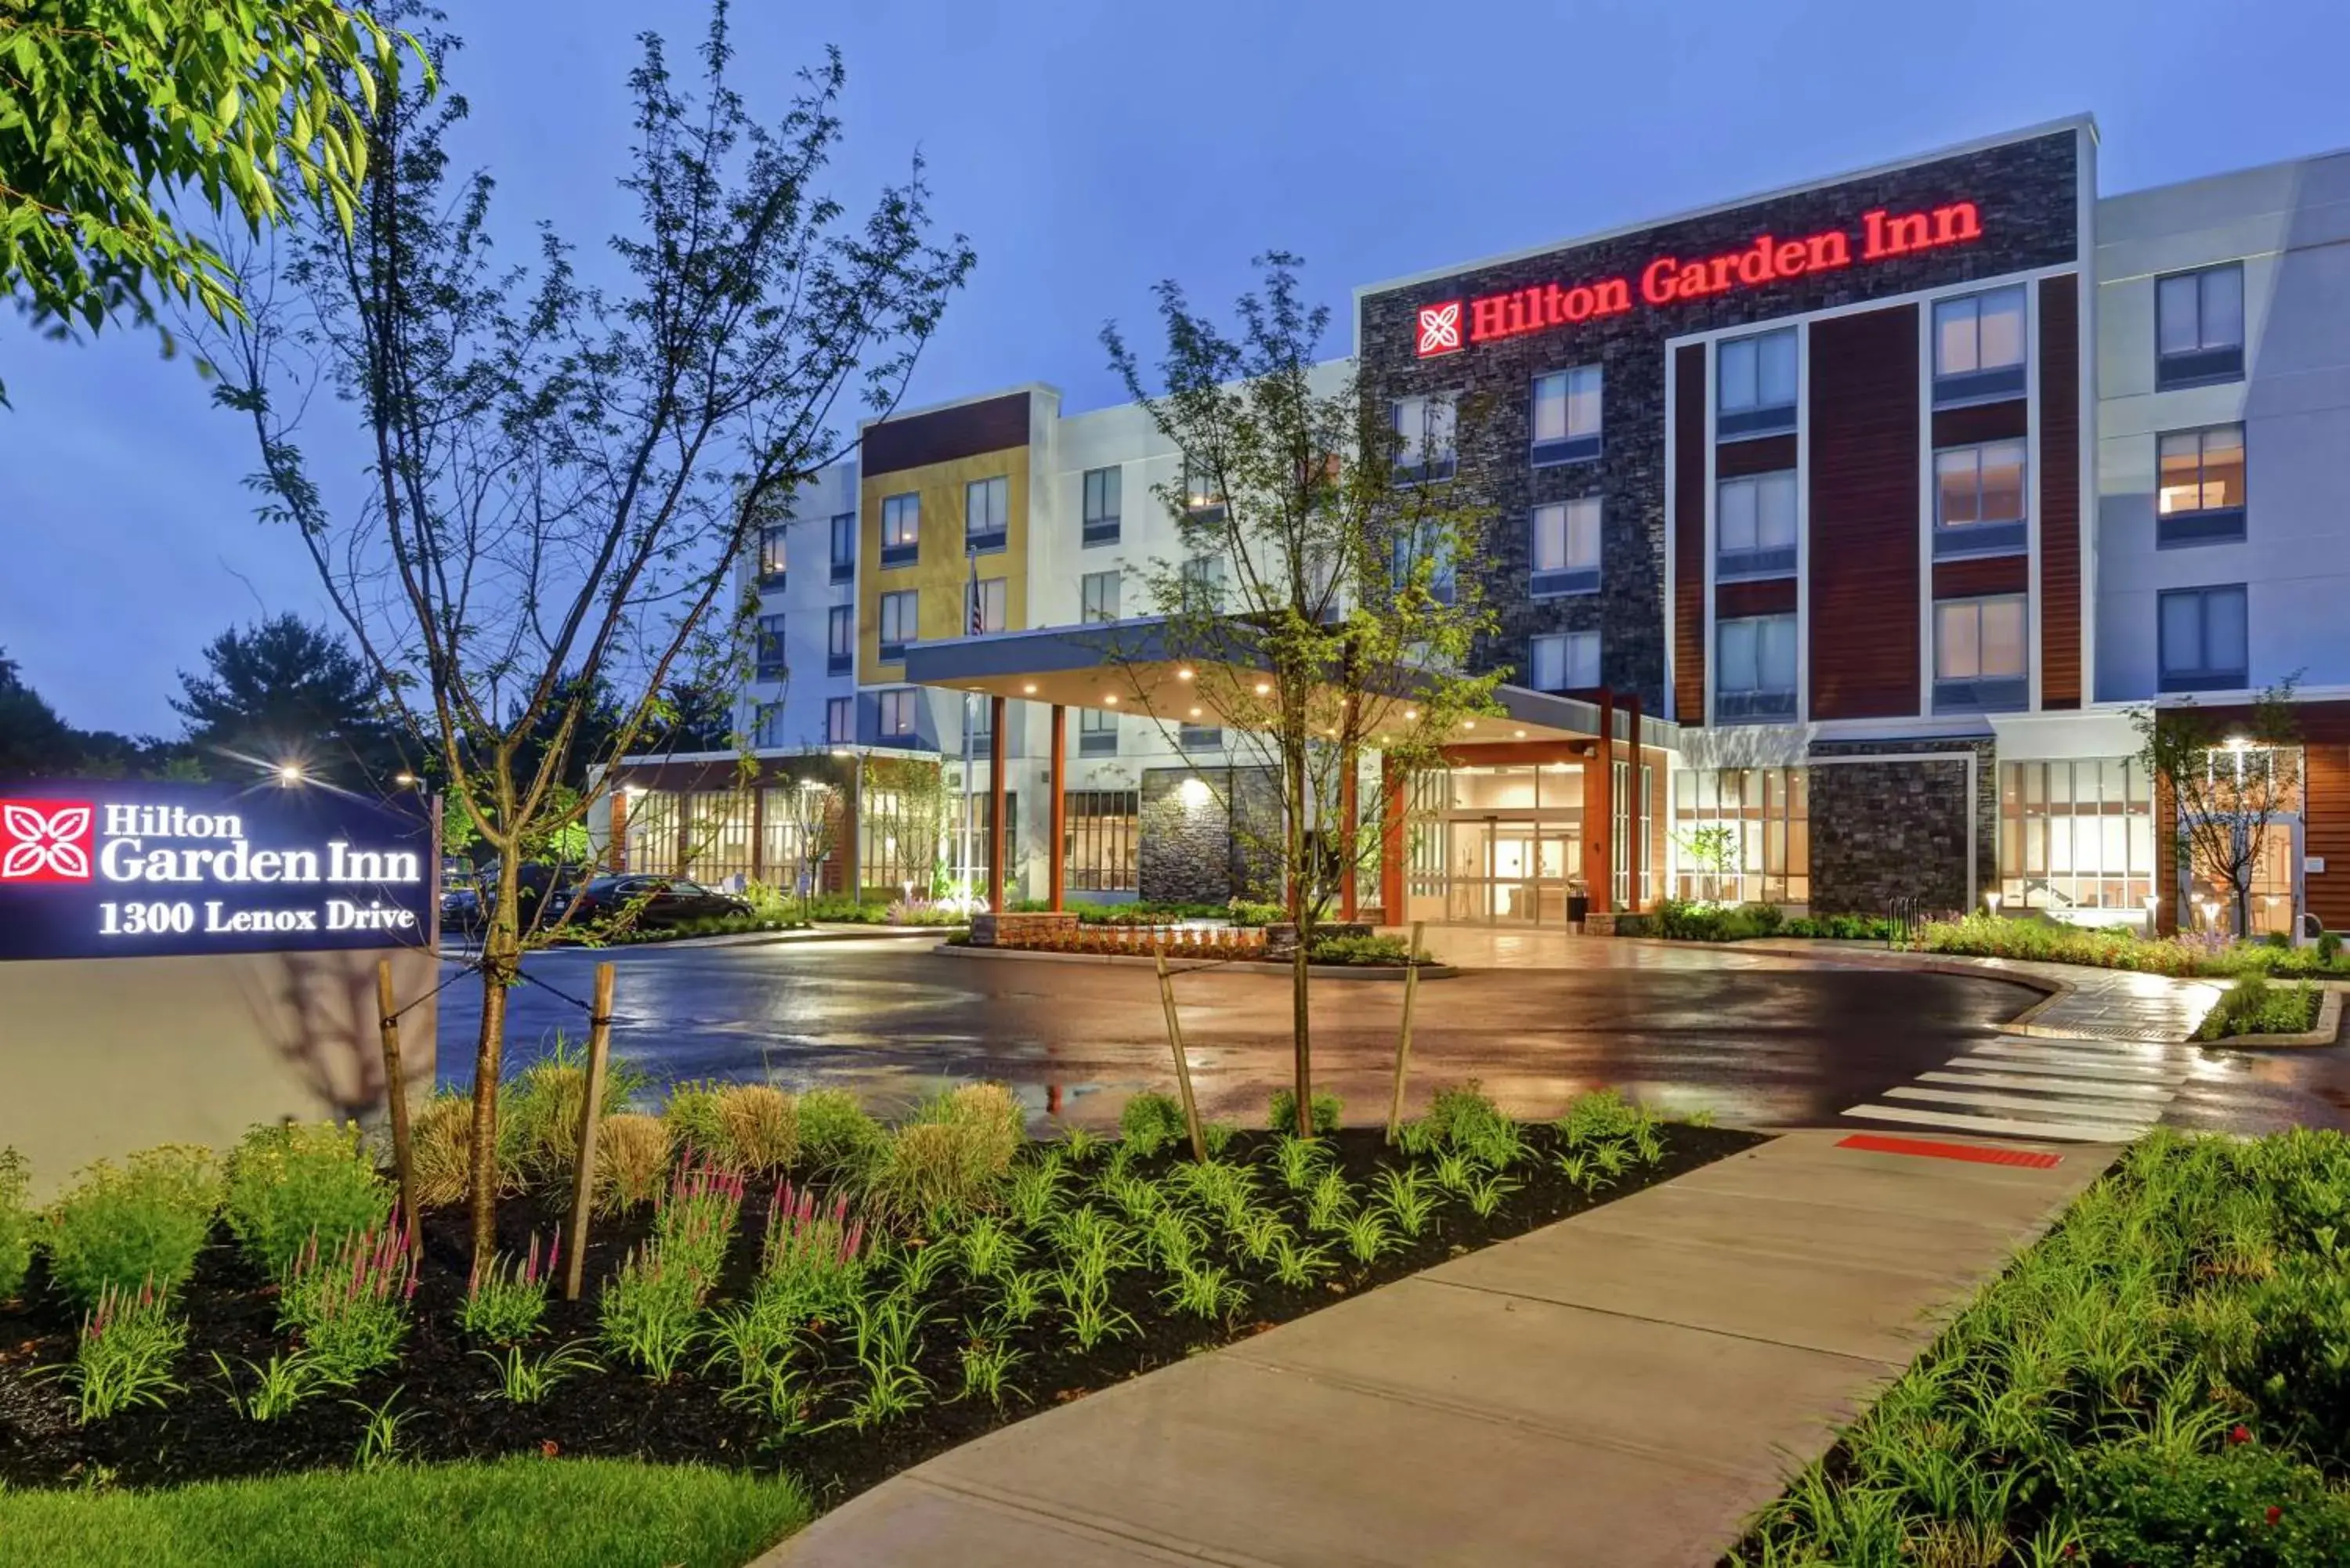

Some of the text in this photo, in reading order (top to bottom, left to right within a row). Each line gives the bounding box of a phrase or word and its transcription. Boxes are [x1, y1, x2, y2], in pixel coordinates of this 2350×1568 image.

[1470, 201, 1981, 342] Hilton Garden Inn
[103, 804, 244, 839] Hilton
[100, 838, 421, 883] Garden Inn
[99, 901, 415, 934] 1300 Lenox Drive
